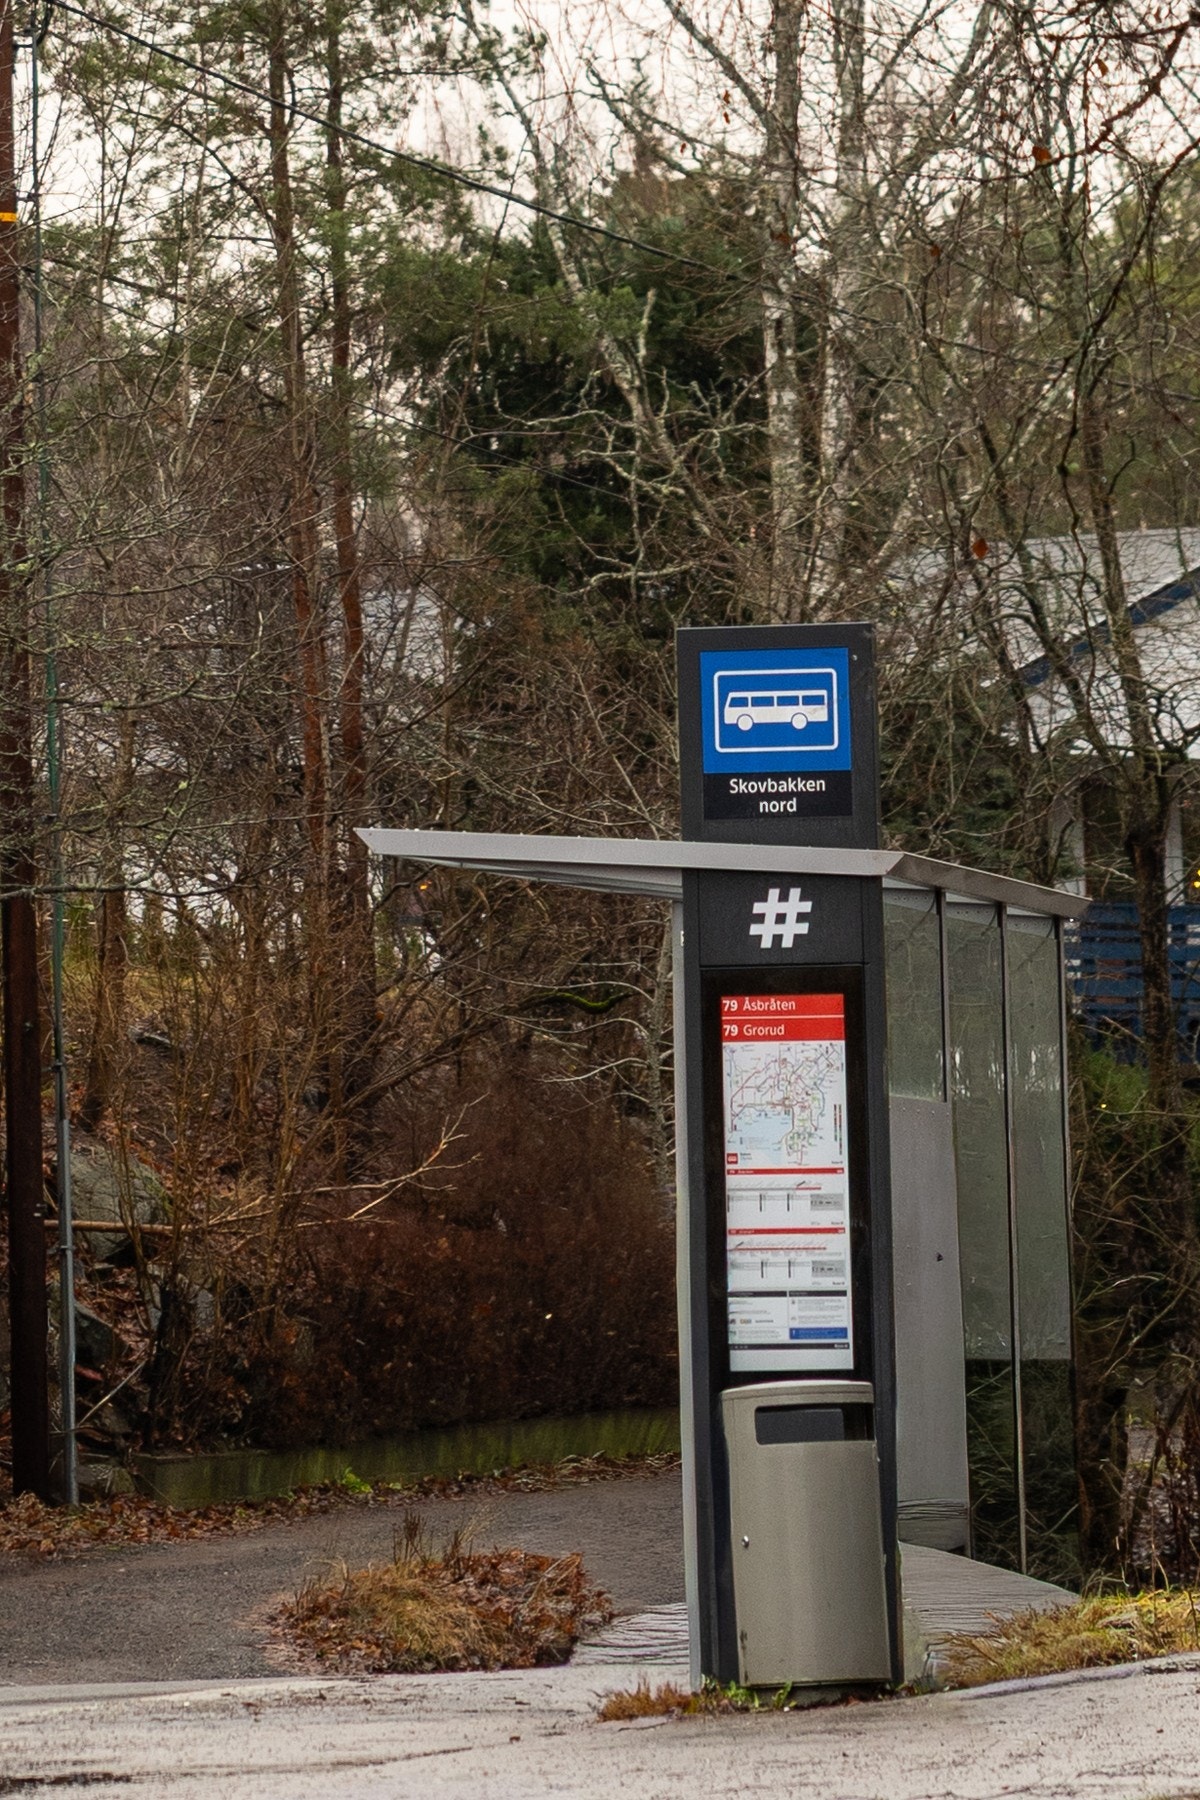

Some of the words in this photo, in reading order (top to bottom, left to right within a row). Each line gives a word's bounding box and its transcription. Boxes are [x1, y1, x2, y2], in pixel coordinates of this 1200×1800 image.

[729, 777, 826, 794] Skovbakken
[759, 797, 797, 813] nord
[749, 888, 812, 949] #
[723, 1000, 738, 1011] 79
[743, 997, 796, 1011] Åsbråten
[723, 1025, 738, 1036] 79
[743, 1024, 785, 1036] Grorud
